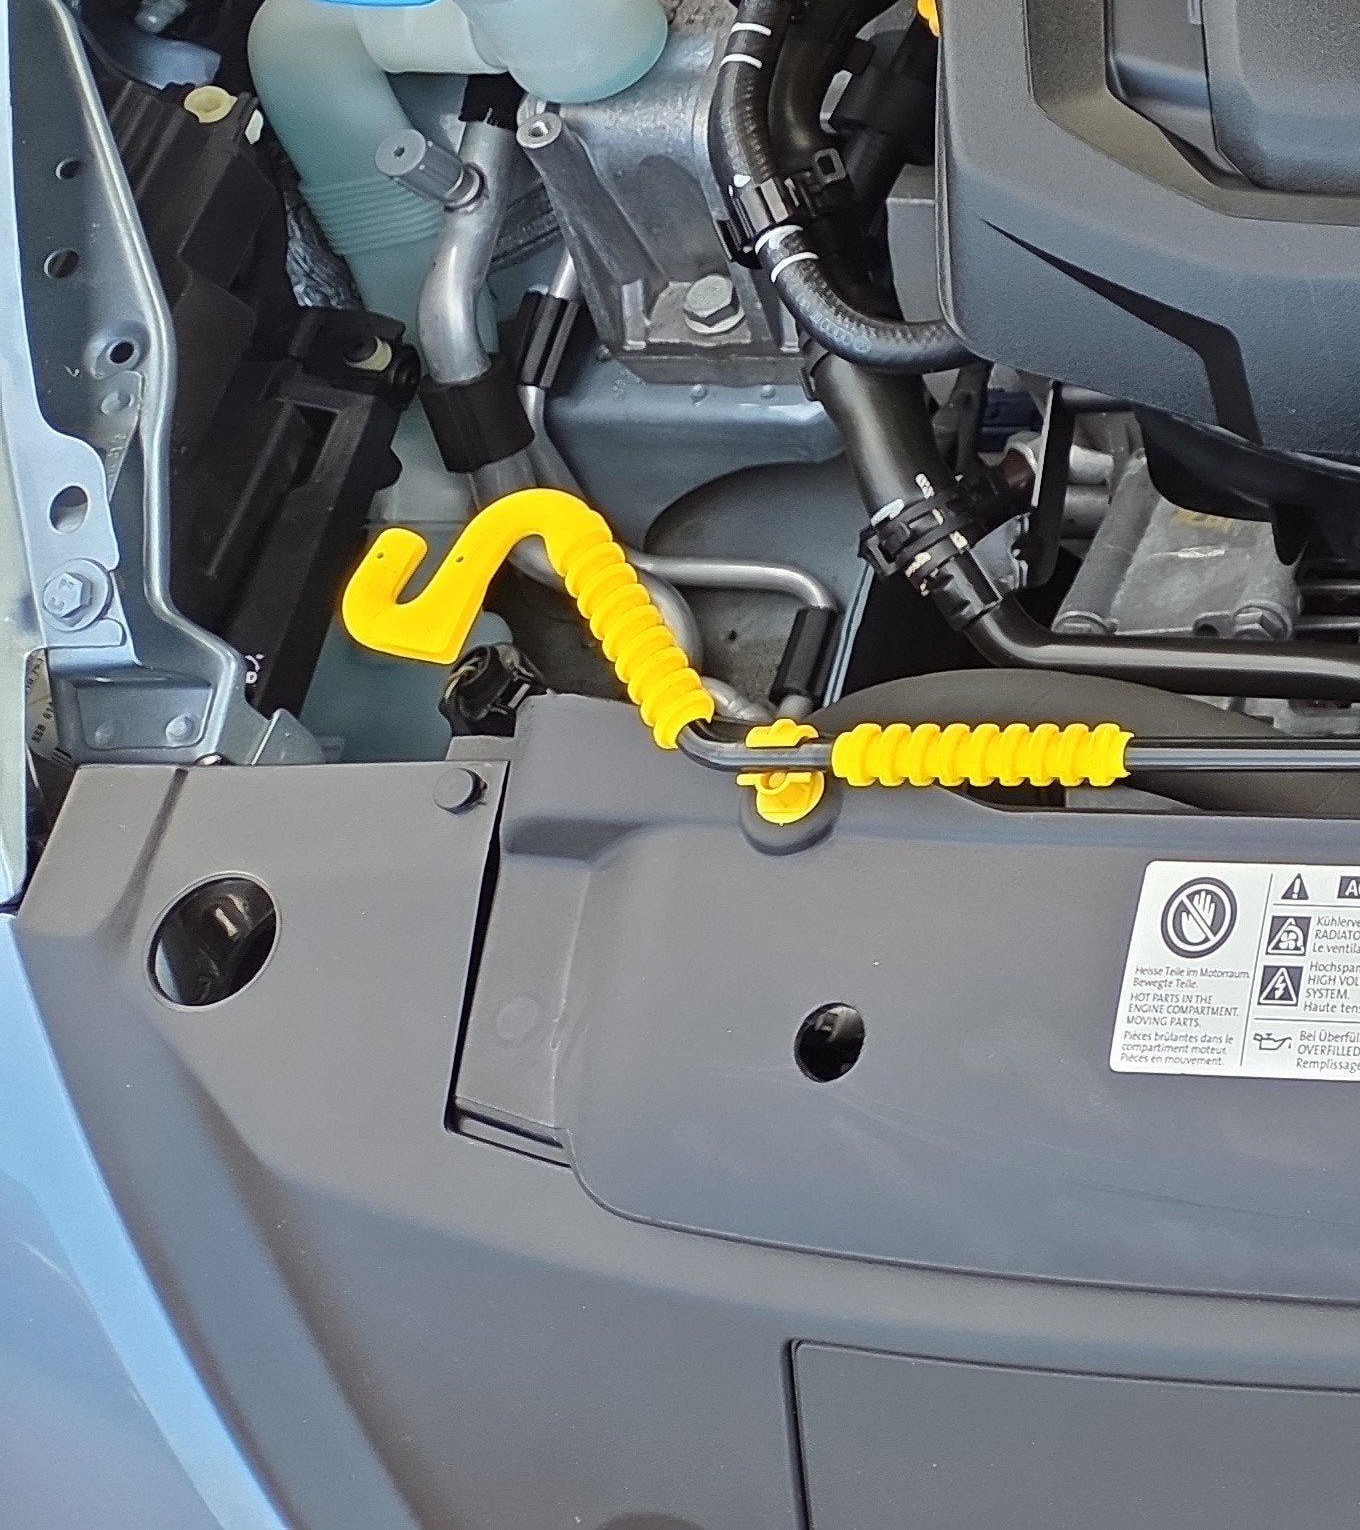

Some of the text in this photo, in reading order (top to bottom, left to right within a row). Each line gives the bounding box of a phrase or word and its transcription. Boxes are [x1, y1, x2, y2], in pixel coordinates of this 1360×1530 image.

[1313, 942, 1324, 953] Le
[1166, 966, 1185, 977] Teile
[1187, 968, 1198, 977] im
[1133, 977, 1198, 990] Bewegte Teile.
[1307, 974, 1337, 986] HIGH
[1130, 993, 1213, 1005] HOT PARTS IN THE
[1305, 988, 1349, 999] SYSTEM.
[1128, 1003, 1164, 1014] ENGINE
[1303, 1001, 1337, 1013] Haute
[1127, 1016, 1168, 1026] MOVING
[1200, 1033, 1223, 1044] dans
[1225, 1034, 1234, 1044] le
[1300, 1030, 1316, 1042] Bei
[1298, 1044, 1360, 1057] OVERFILLED
